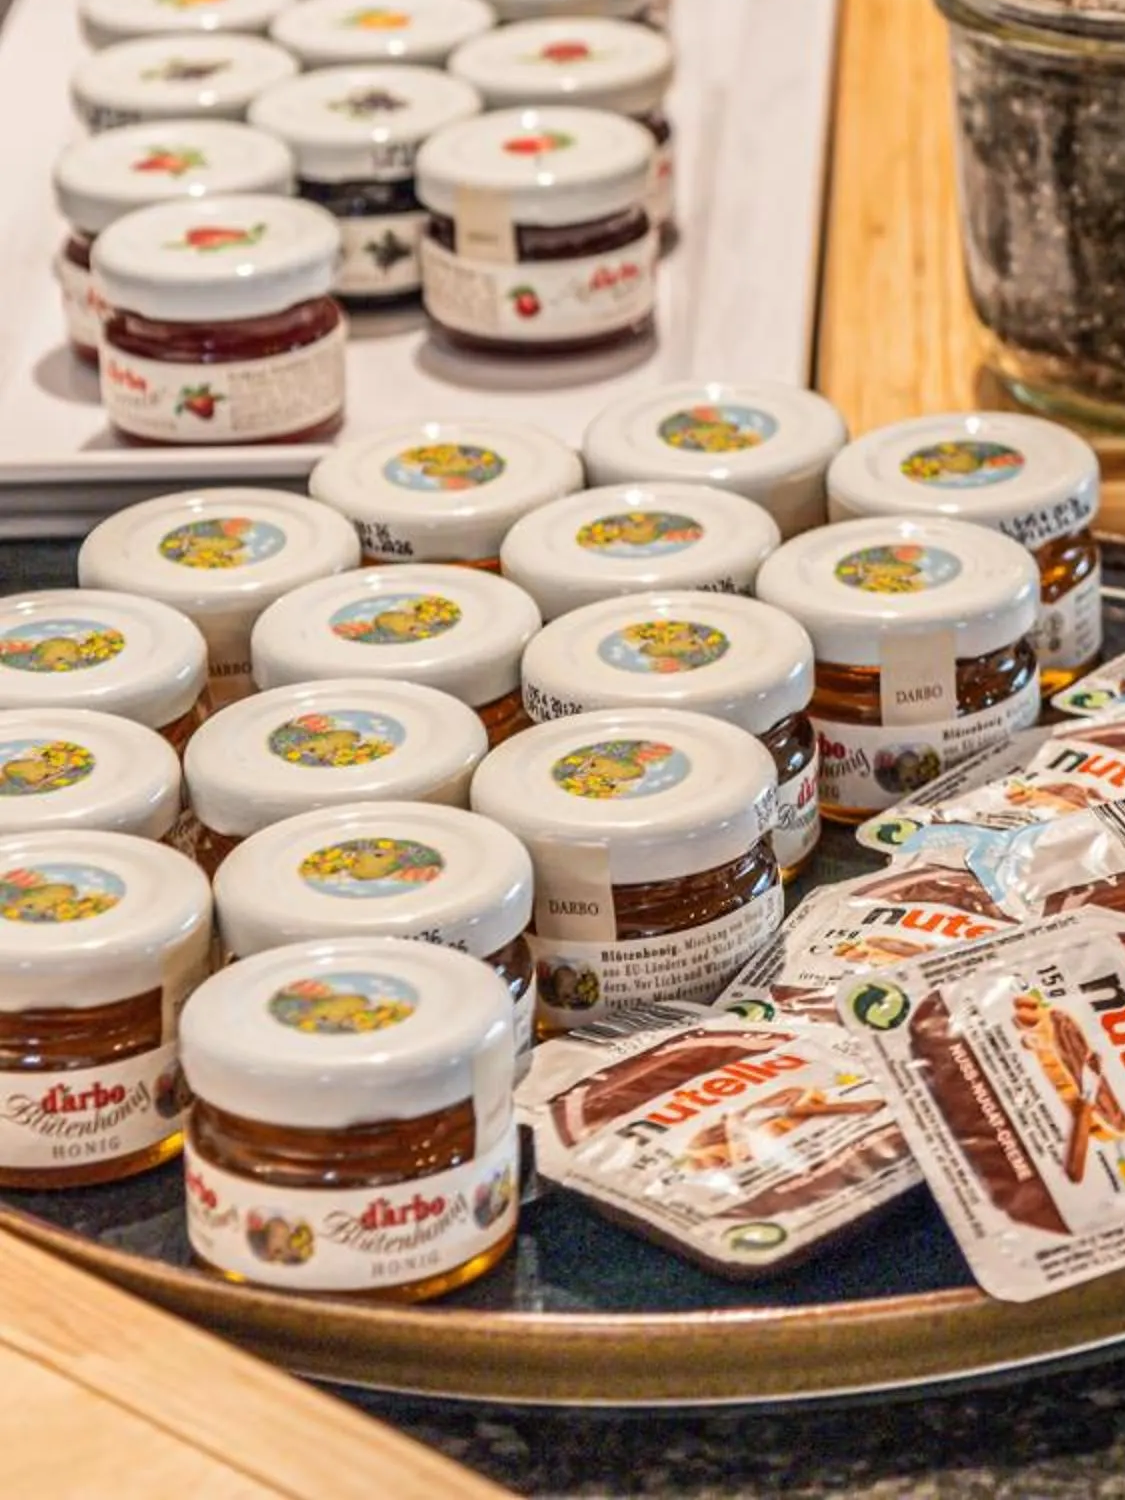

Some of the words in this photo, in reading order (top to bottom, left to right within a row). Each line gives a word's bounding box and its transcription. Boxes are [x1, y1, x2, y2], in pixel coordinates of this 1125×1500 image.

[896, 685, 943, 705] DARBO
[549, 900, 600, 917] DARBO
[614, 1054, 811, 1146] nutella
[52, 1136, 122, 1160] HONIG
